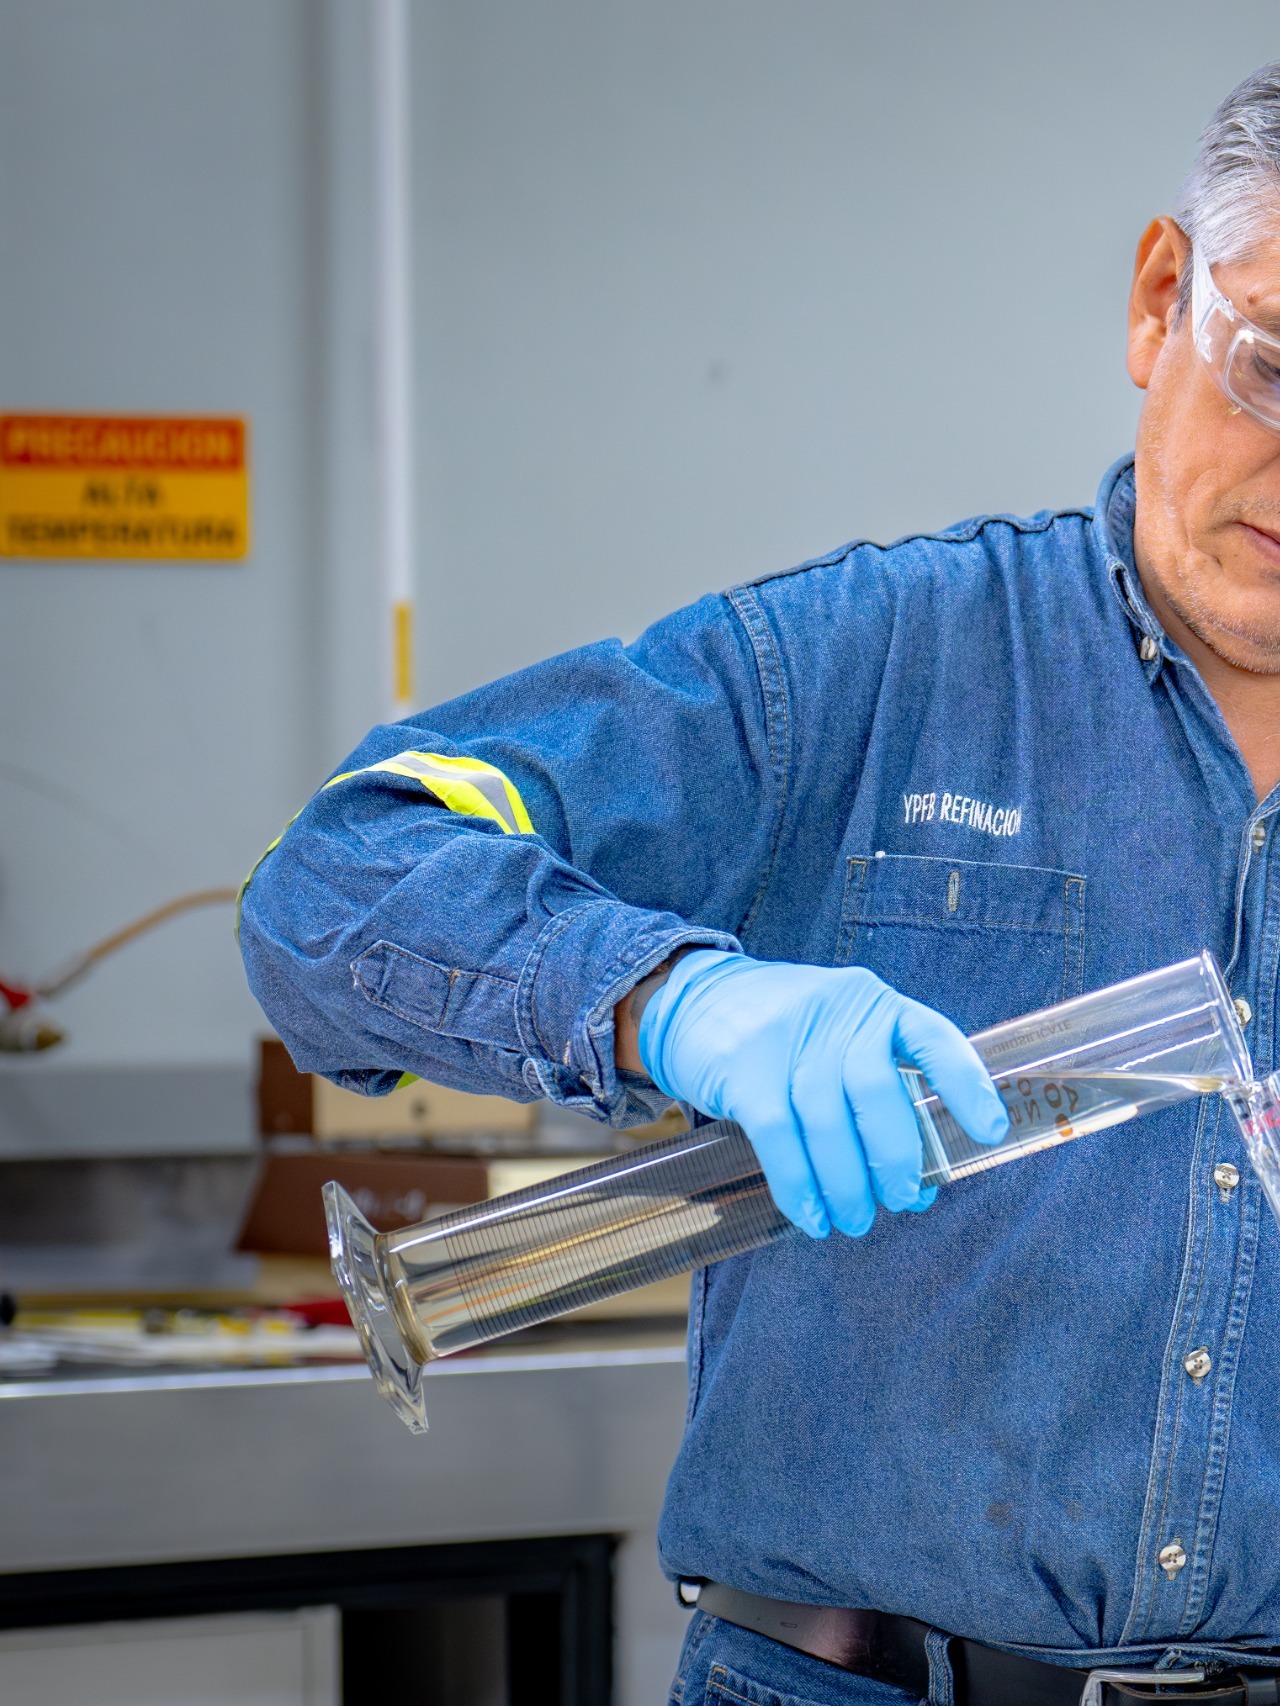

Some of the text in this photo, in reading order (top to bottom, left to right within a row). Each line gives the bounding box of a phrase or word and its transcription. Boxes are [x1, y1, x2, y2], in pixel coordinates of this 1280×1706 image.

[82, 477, 164, 509] ALTA
[7, 514, 236, 547] TEMPERATURA
[904, 793, 936, 824] YPFB
